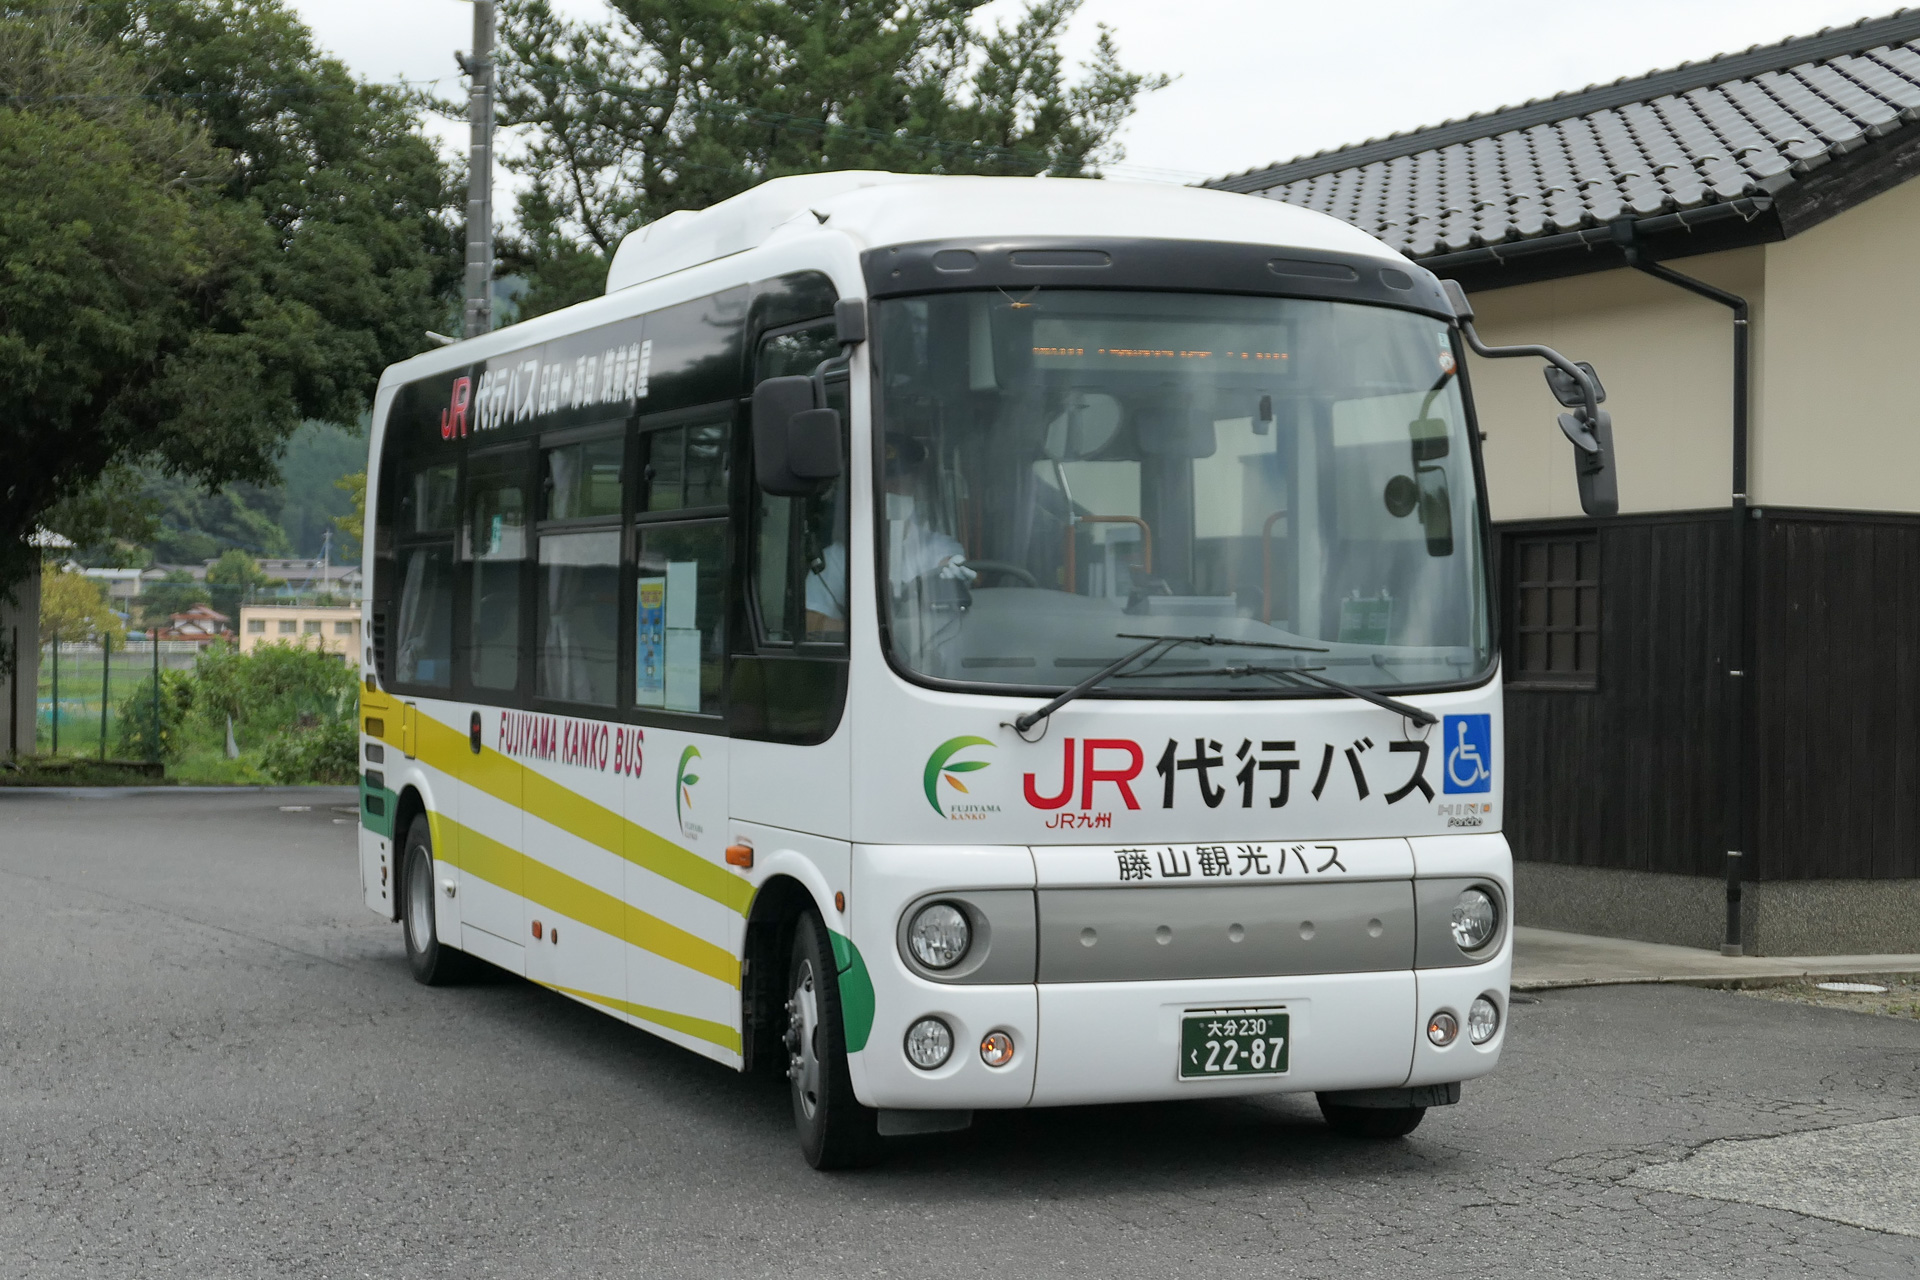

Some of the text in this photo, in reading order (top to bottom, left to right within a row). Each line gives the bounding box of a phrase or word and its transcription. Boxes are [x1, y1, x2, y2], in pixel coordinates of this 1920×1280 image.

[499, 711, 644, 778] FUJIYAMA KANKO BUS
[1045, 812, 1112, 829] JR九州
[1438, 802, 1492, 816] HINO
[1114, 845, 1347, 881] 藤山観光バス
[1205, 1037, 1284, 1072] 22-87
